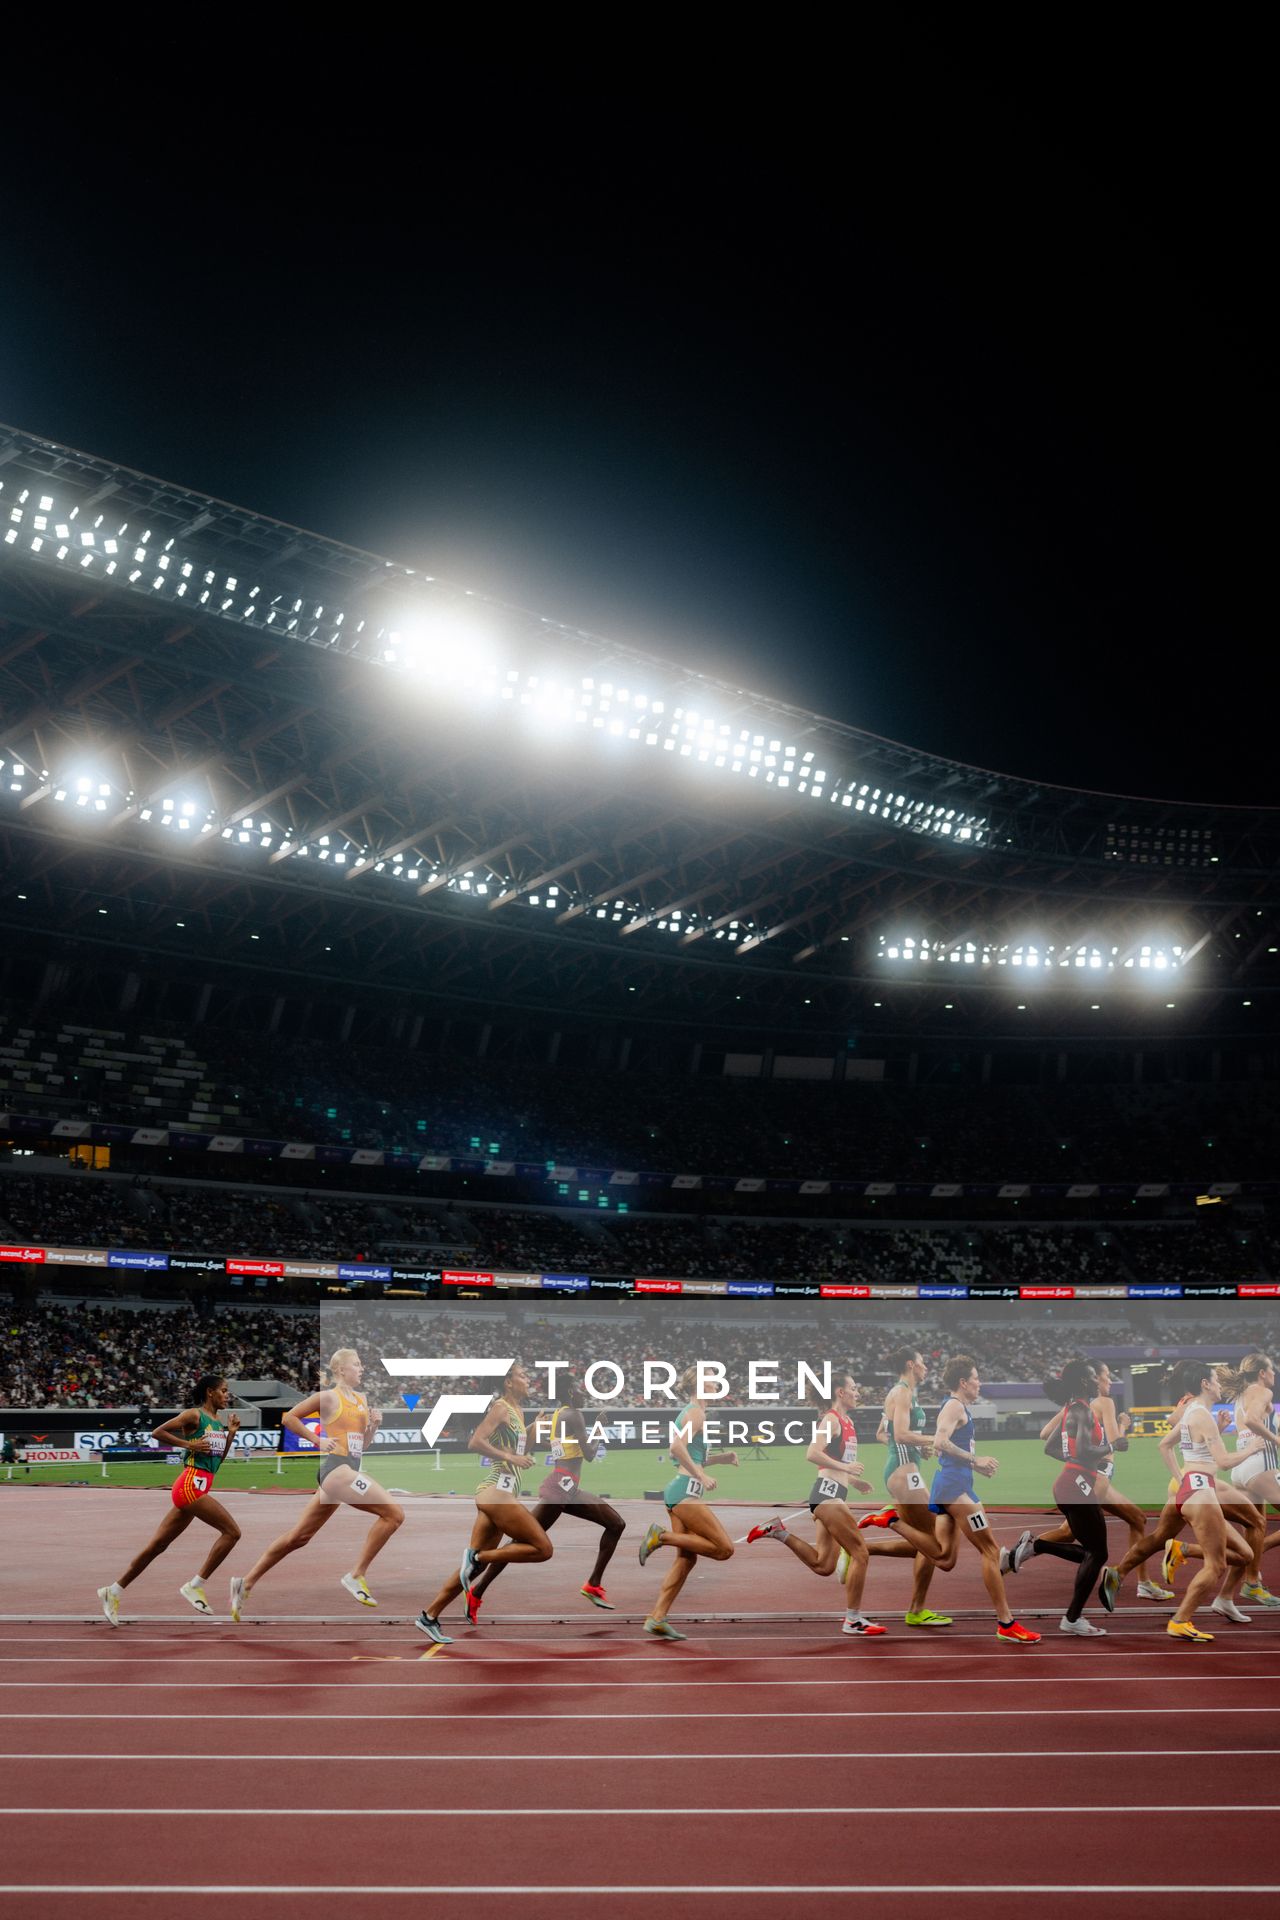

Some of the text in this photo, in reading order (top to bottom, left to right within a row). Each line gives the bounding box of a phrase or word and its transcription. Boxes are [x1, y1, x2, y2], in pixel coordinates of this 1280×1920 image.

[25, 1451, 81, 1461] HONDA
[197, 1479, 204, 1490] 7
[355, 1479, 367, 1491] 8
[502, 1476, 510, 1489] 5
[690, 1480, 702, 1494] 12
[823, 1479, 838, 1495] 14
[912, 1475, 920, 1487] 9
[1195, 1475, 1204, 1487] 3
[970, 1514, 986, 1528] 11
